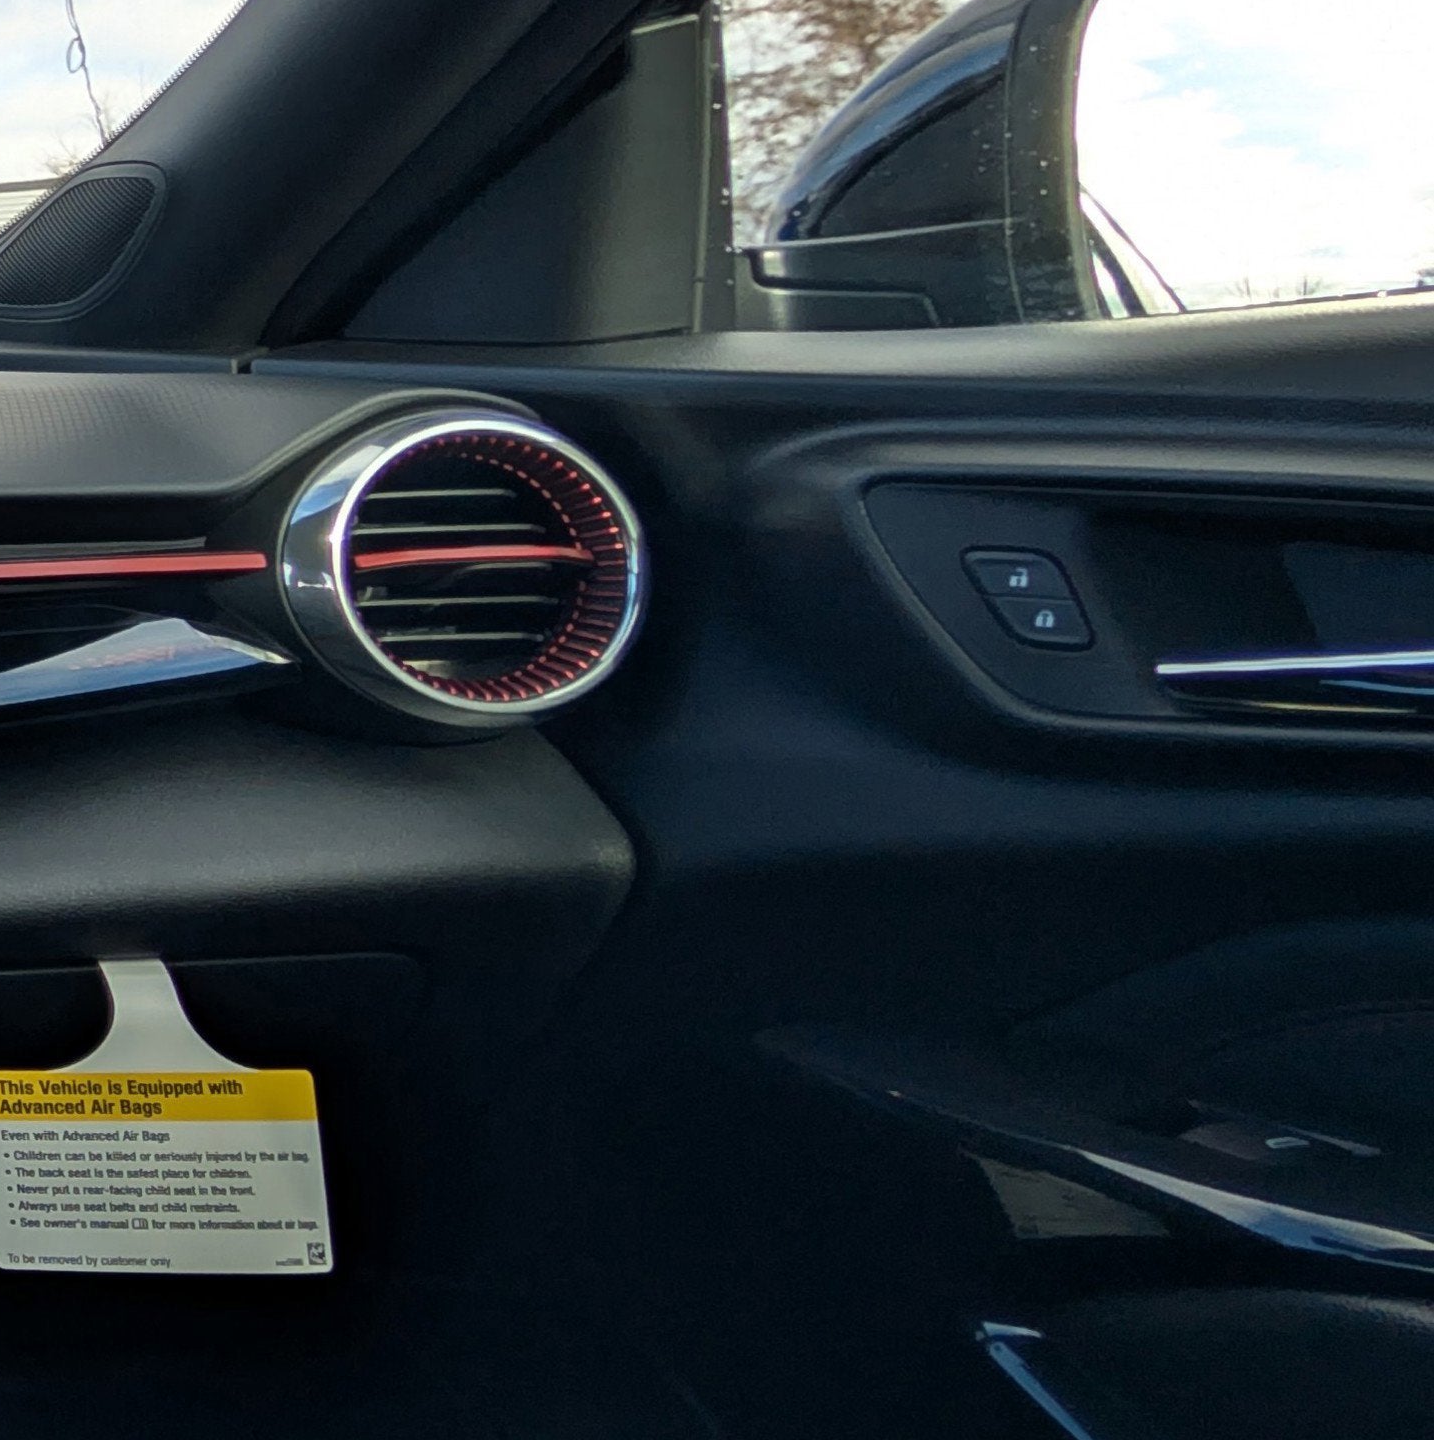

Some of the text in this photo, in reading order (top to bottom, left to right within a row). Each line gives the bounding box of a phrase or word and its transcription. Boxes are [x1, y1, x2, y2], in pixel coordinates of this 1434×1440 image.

[38, 1079, 103, 1095] Vehicle
[108, 1079, 123, 1095] is
[127, 1079, 203, 1098] Equipped
[208, 1079, 243, 1095] with
[0, 1099, 162, 1118] Advanced Air Bags
[1, 1129, 170, 1143] Even with Advanced Air Bags
[13, 1150, 61, 1161] Children
[65, 1152, 86, 1161] can
[88, 1151, 103, 1161] be
[106, 1152, 136, 1161] killed
[139, 1153, 151, 1161] or
[154, 1152, 202, 1163] seriously
[205, 1152, 242, 1163] injured
[244, 1152, 257, 1163] by
[15, 1167, 35, 1178] The
[38, 1168, 65, 1178] back
[68, 1168, 91, 1178] seat
[94, 1169, 104, 1178] is
[106, 1169, 124, 1178] the
[126, 1169, 159, 1178] safest
[161, 1169, 190, 1180] place
[192, 1169, 207, 1178] for
[17, 1184, 49, 1194] Never
[52, 1185, 71, 1196] put
[83, 1185, 143, 1197] rear-facing
[145, 1186, 171, 1195] child
[174, 1186, 196, 1196] seat
[199, 1186, 209, 1195] in
[211, 1186, 227, 1195] the
[18, 1201, 58, 1213] Always
[61, 1203, 81, 1211] use
[84, 1202, 107, 1212] seat
[109, 1202, 136, 1212] belts
[138, 1203, 159, 1212] and
[161, 1203, 187, 1213] child
[20, 1218, 40, 1228] See
[44, 1218, 87, 1229] owner's
[90, 1219, 129, 1229] manual
[152, 1220, 166, 1229] for
[169, 1222, 196, 1230] more
[199, 1220, 255, 1230] information
[7, 1253, 19, 1264] To
[22, 1254, 35, 1264] be
[38, 1255, 82, 1265] removed
[86, 1256, 97, 1267] by
[101, 1256, 147, 1266] customer
